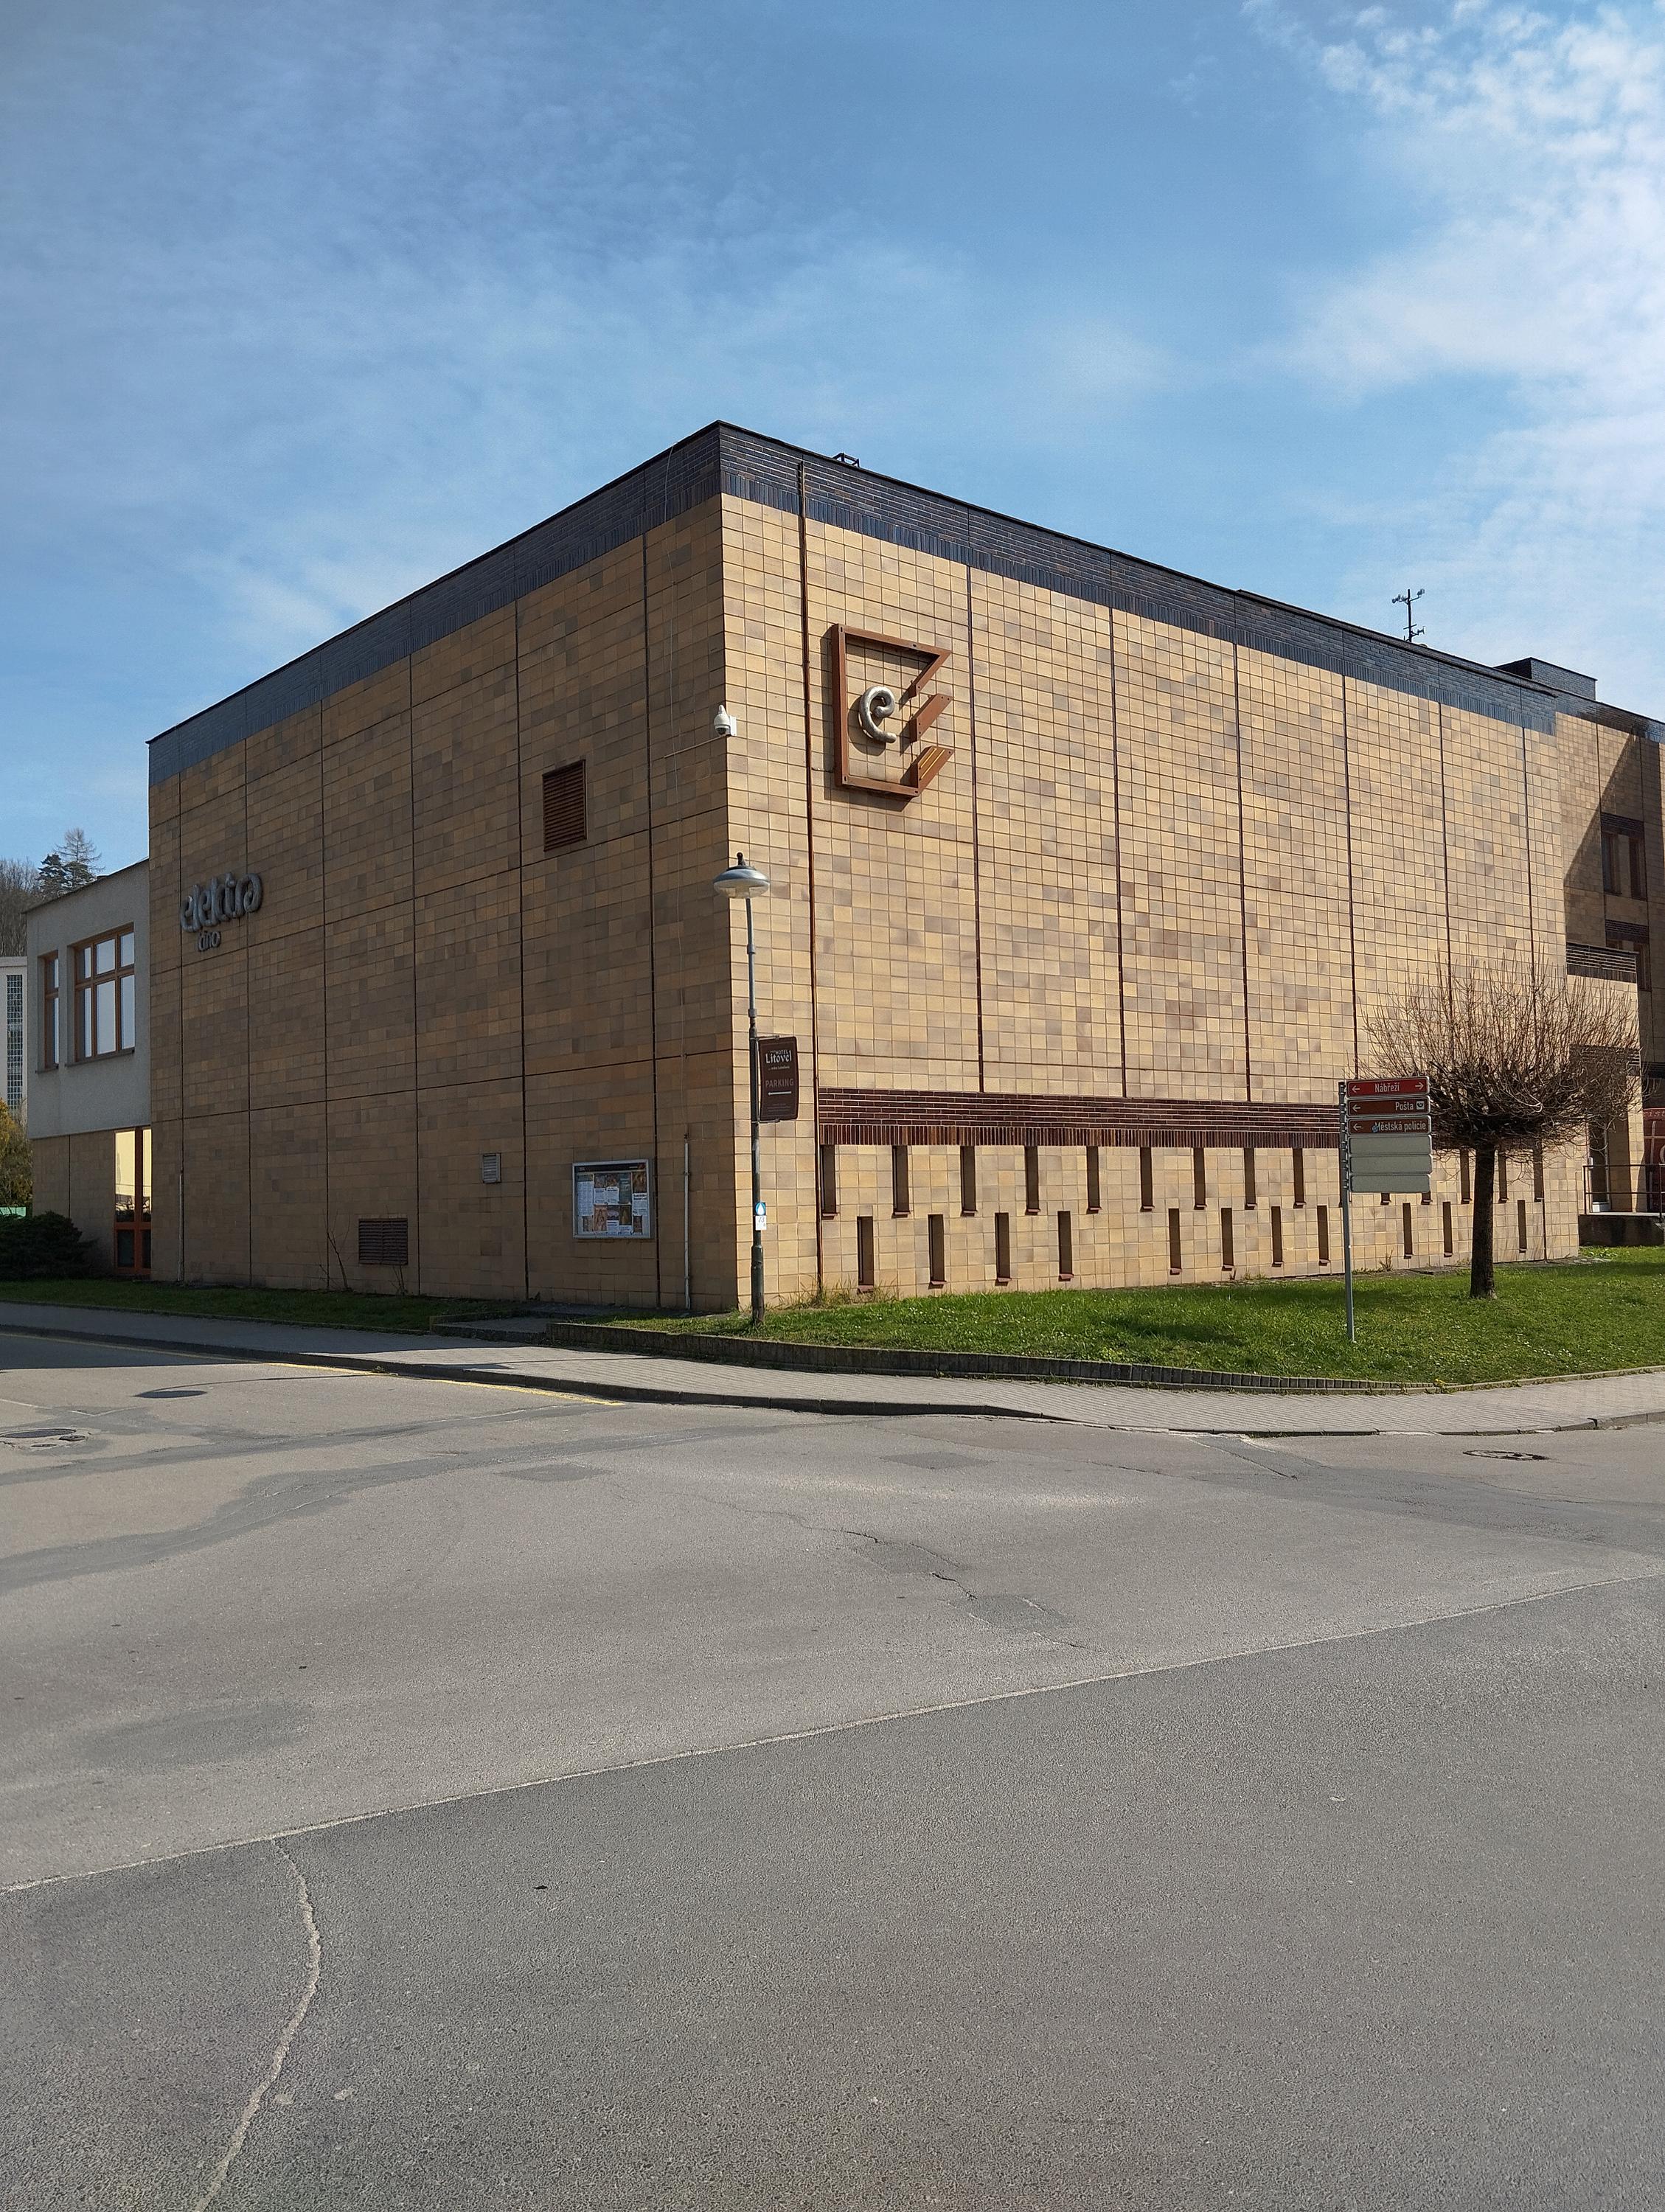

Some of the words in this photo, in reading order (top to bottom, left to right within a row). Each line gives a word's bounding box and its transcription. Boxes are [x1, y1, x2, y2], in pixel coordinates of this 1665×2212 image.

[765, 1050, 792, 1064] Litovel
[765, 1078, 794, 1088] PARKING
[1374, 1082, 1400, 1093] Nábřeží
[1395, 1101, 1414, 1110] Pošta
[1404, 1120, 1427, 1133] policie
